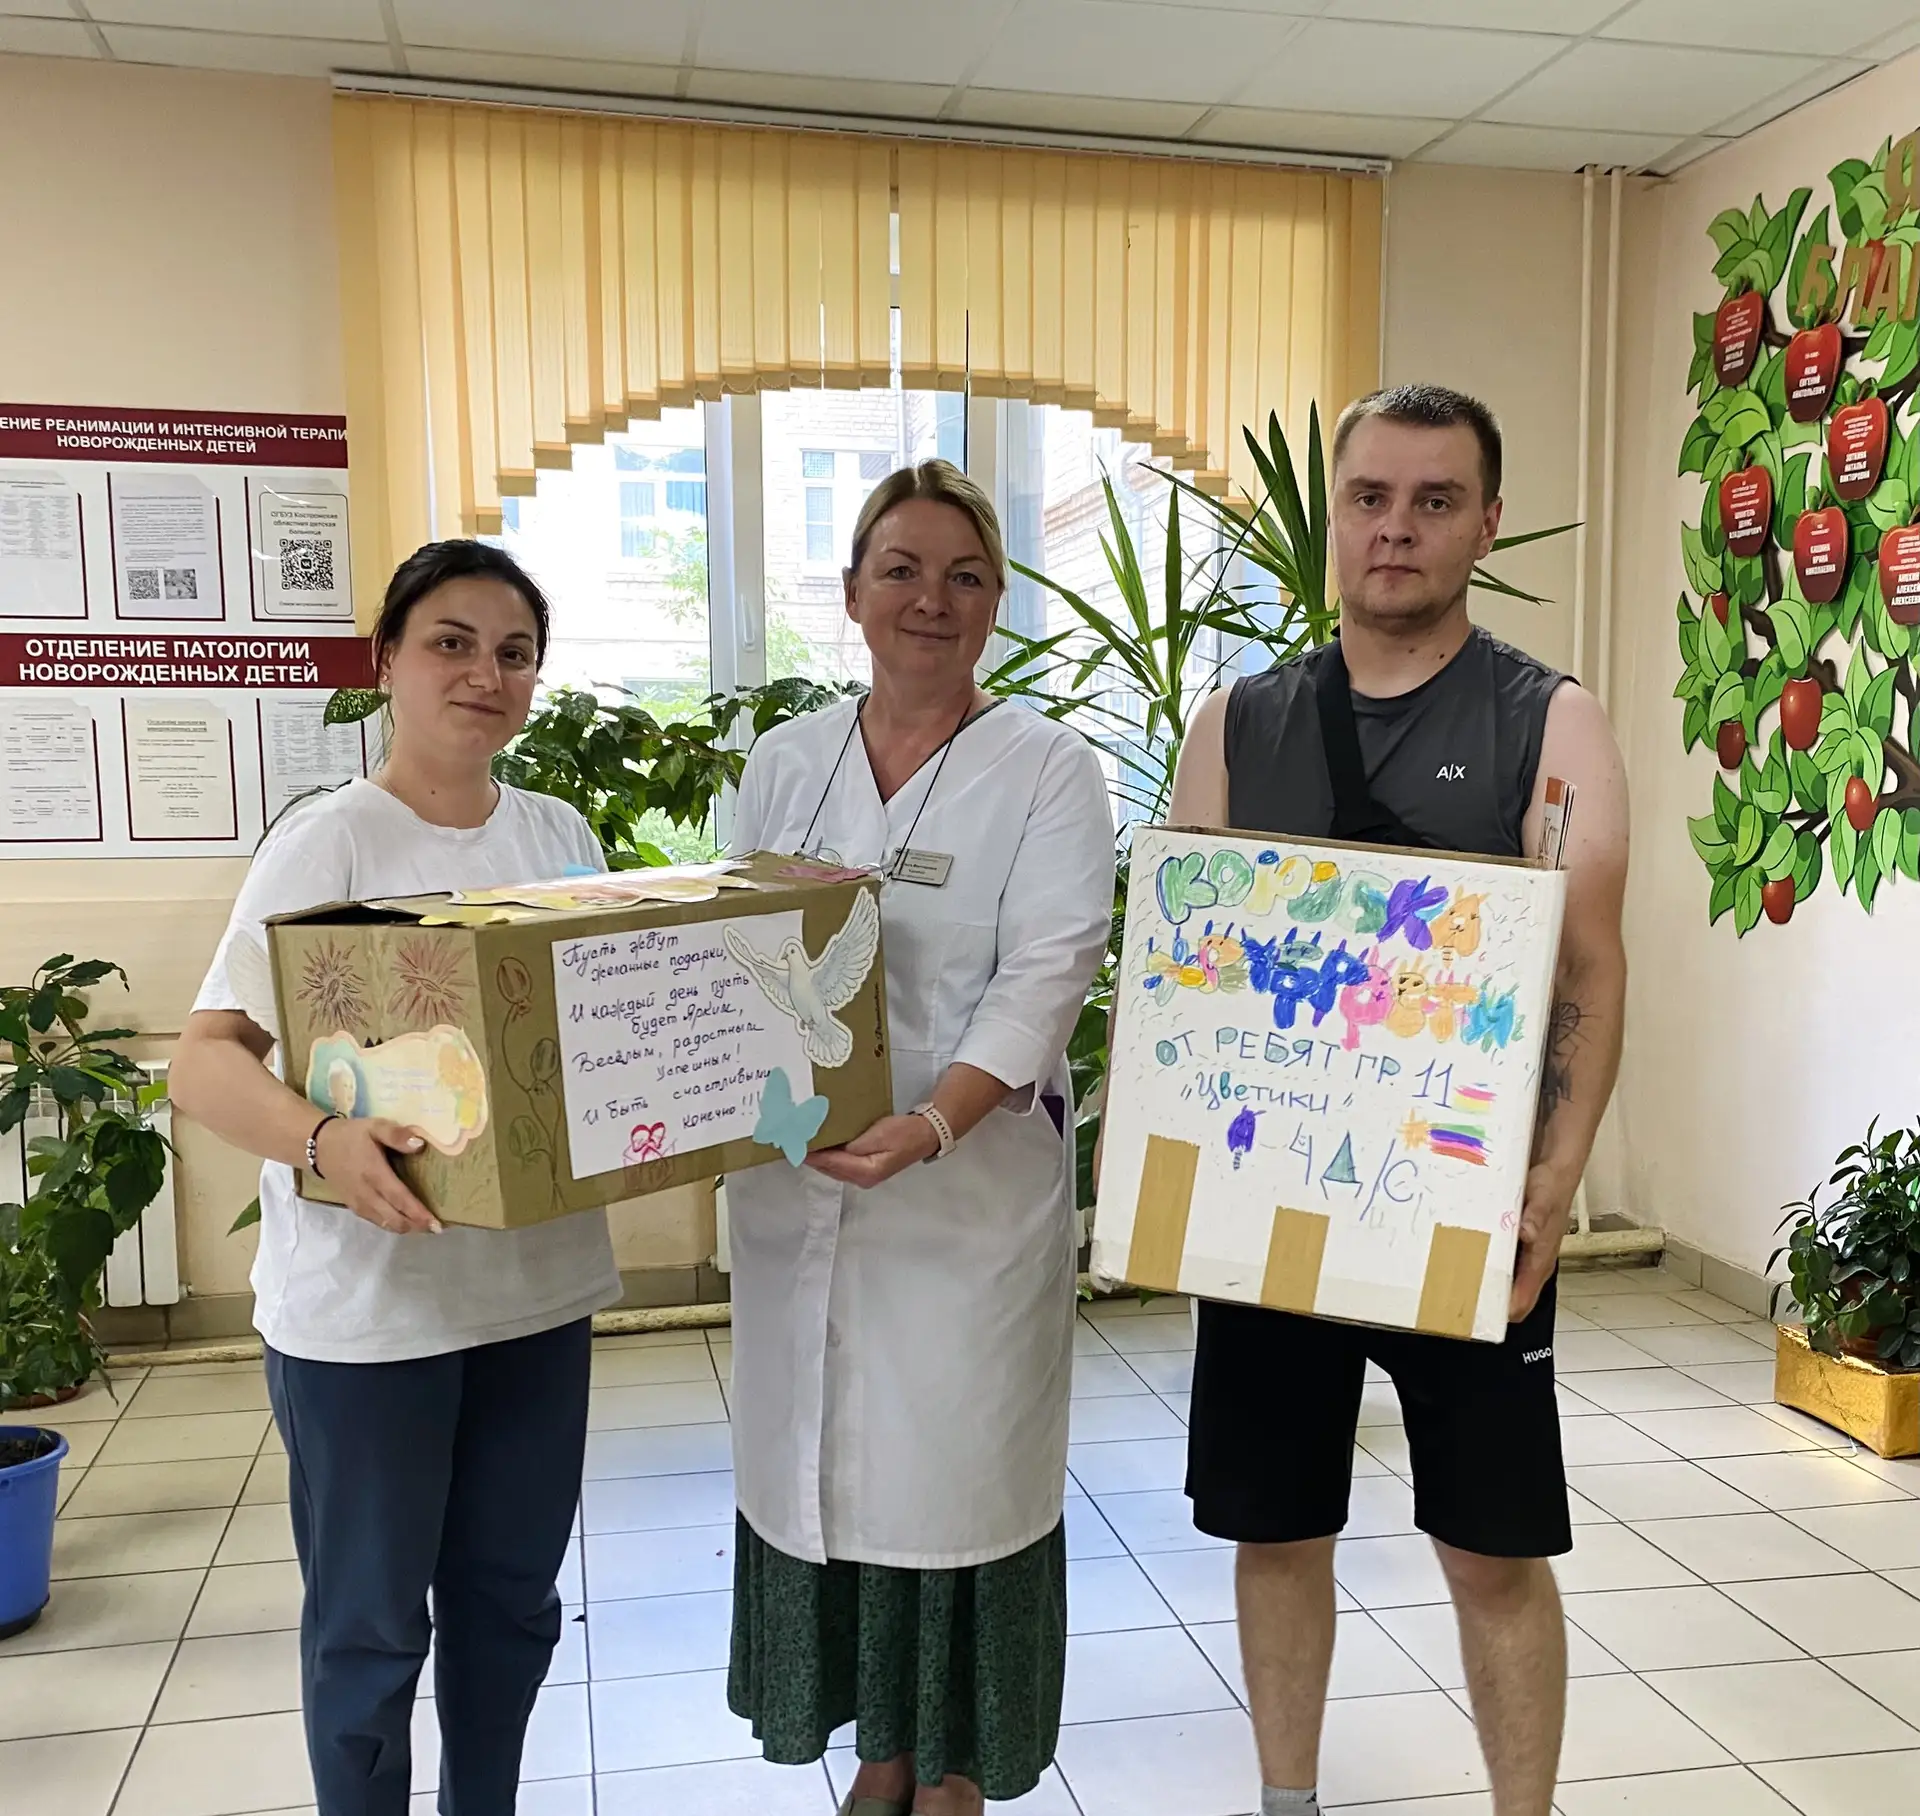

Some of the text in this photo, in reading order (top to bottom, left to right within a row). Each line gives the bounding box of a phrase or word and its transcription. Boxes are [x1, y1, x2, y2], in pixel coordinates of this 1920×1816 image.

[45, 418, 154, 435] РЕАНИМАЦИИ
[159, 422, 168, 434] И
[173, 422, 287, 439] ИНТЕНСИВНОЙ
[57, 435, 256, 454] НОВОРОЖДЕННЫХ ДЕТЕЙ
[25, 638, 310, 661] ОТДЕЛЕНИЕ ПАТОЛОГИИ
[19, 661, 319, 685] НОВОРОЖДЕННЫХ ДЕТЕЙ
[1155, 848, 1482, 958] КОРОБКА
[562, 931, 679, 977] Пусть ждут
[591, 948, 728, 985] желанные подарки,
[592, 992, 656, 1020] каждый
[665, 988, 699, 1011] день
[711, 971, 750, 999] пусть
[631, 1013, 677, 1040] будет
[673, 1022, 766, 1059] радостным
[1155, 1030, 1196, 1066] ОТ
[1215, 1026, 1341, 1071] РЕБЯТ
[1411, 1058, 1453, 1109] 11
[605, 1096, 649, 1120] быть
[1522, 1347, 1552, 1365] HUGO
